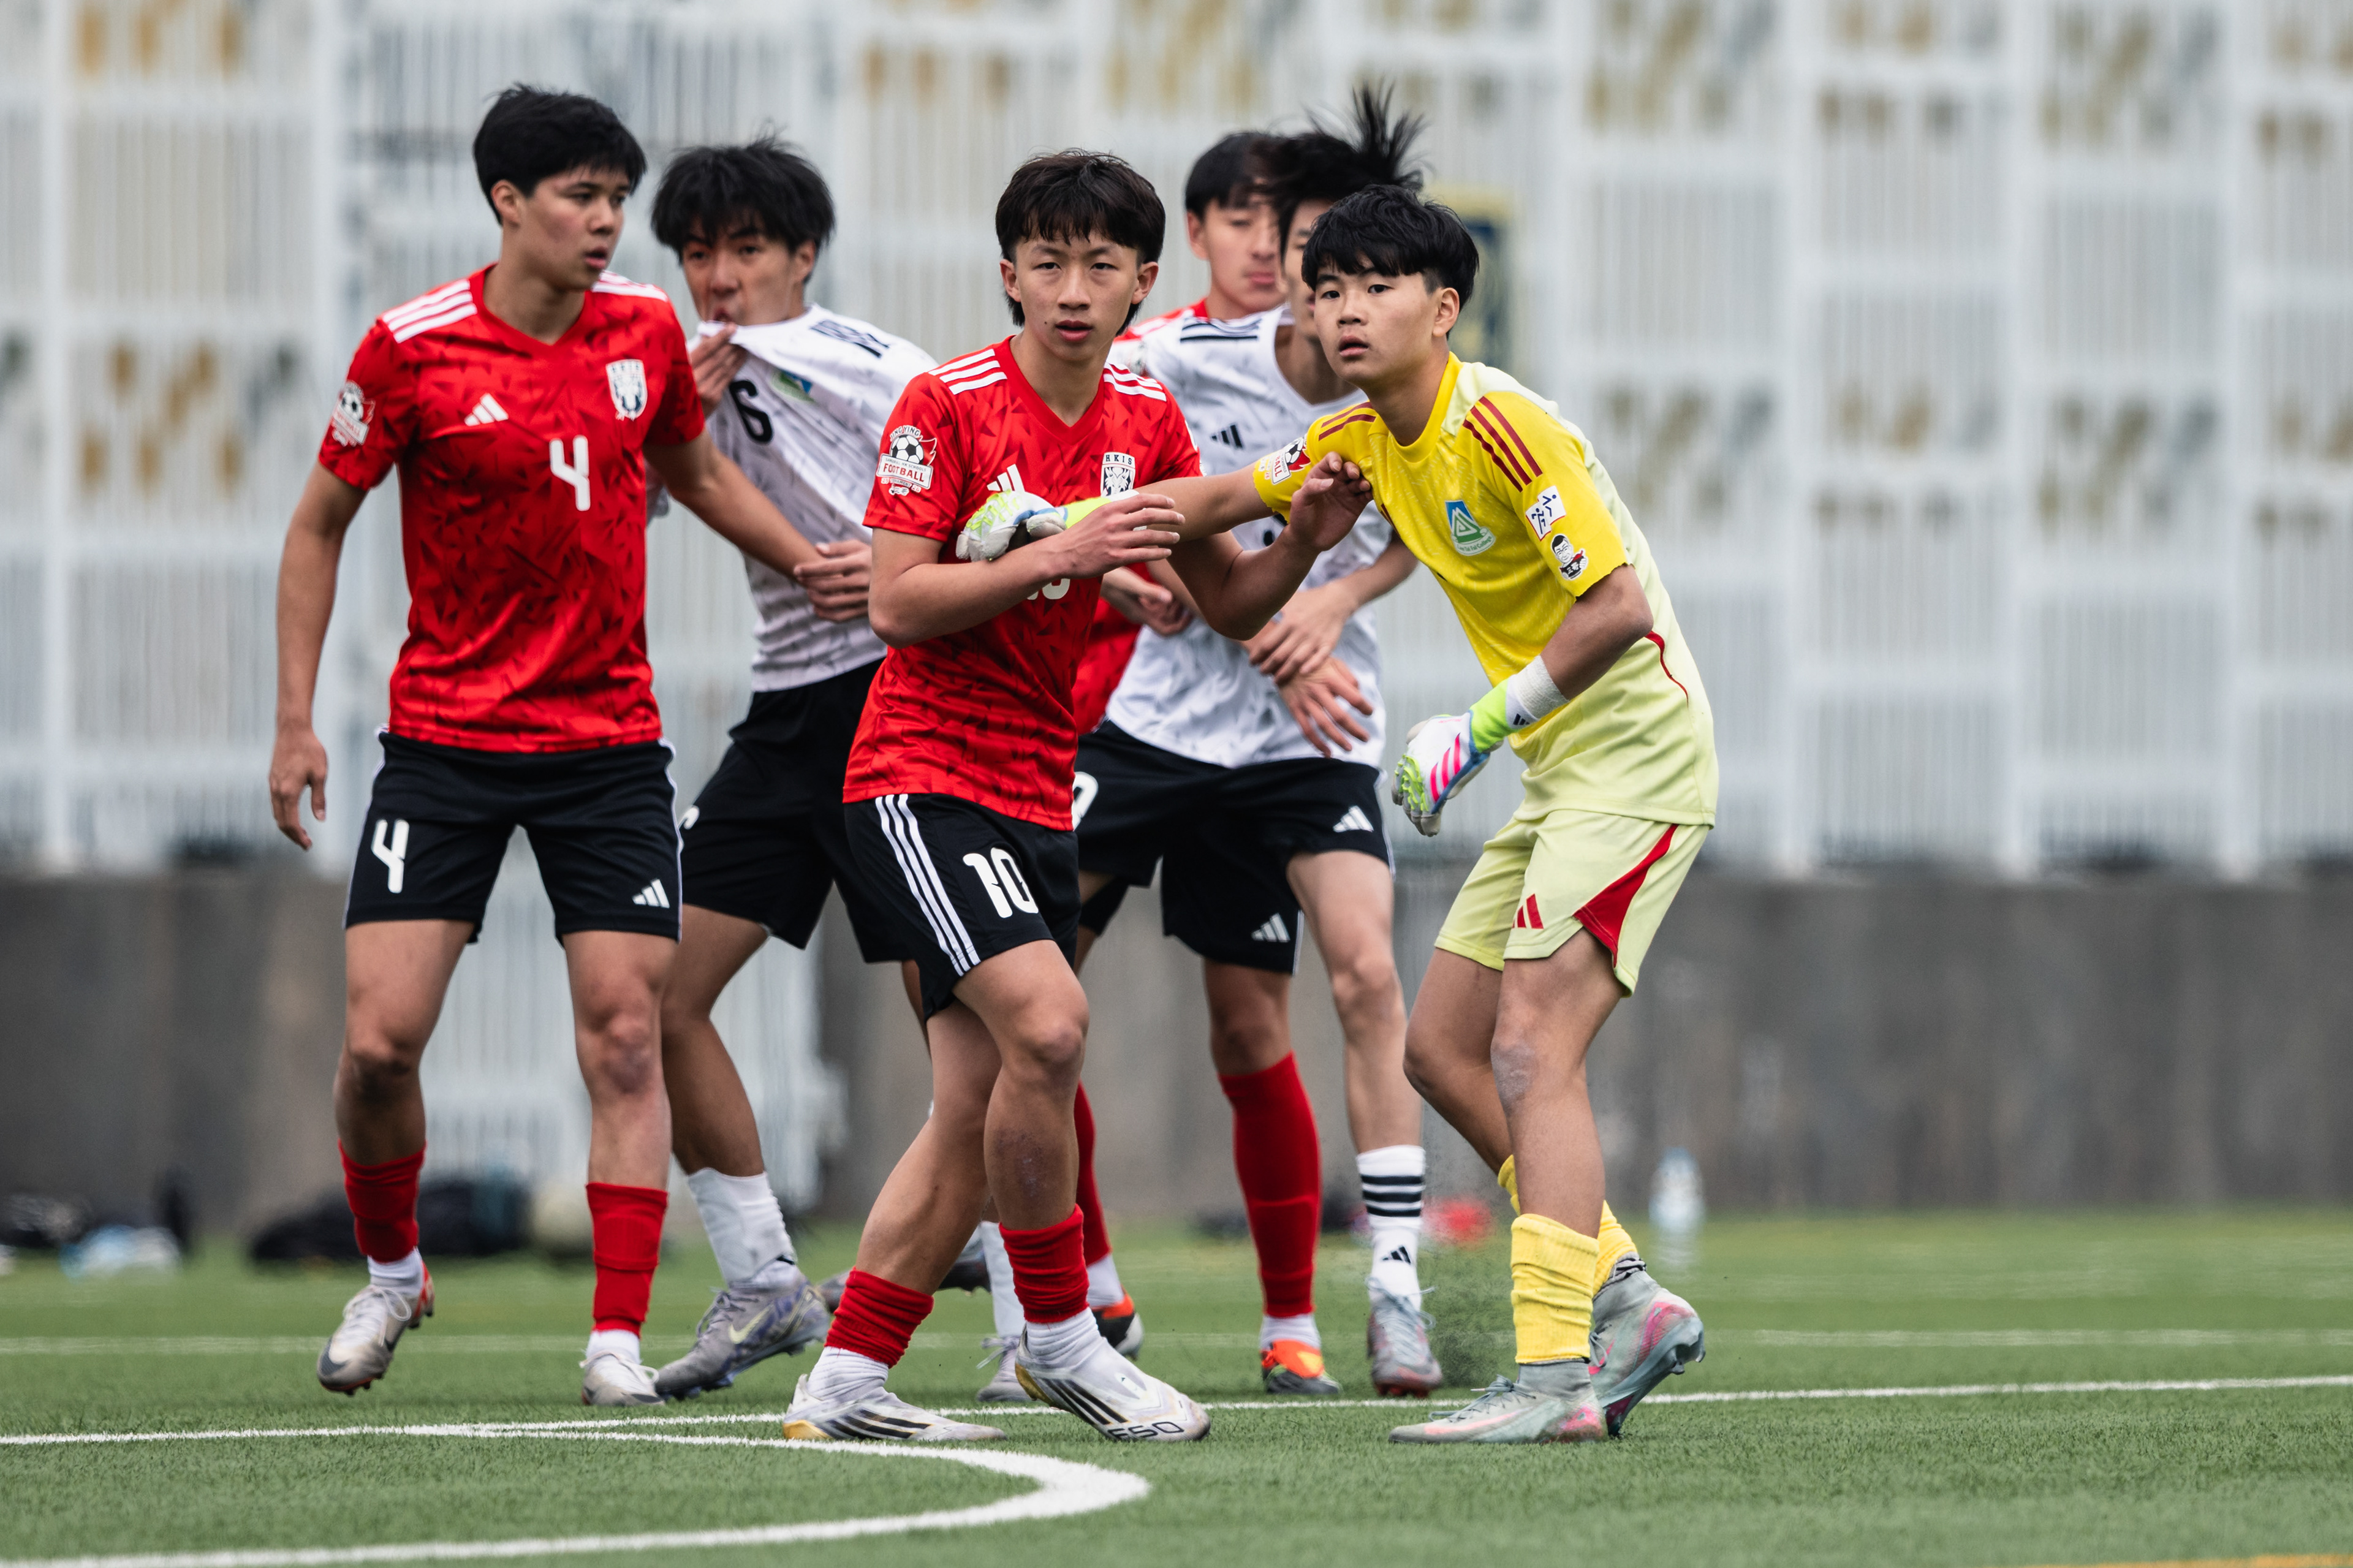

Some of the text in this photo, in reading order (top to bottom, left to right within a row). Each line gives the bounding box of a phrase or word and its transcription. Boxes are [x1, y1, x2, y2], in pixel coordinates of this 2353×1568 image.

[728, 379, 774, 446] 6
[904, 426, 920, 436] YING
[549, 434, 591, 512] 4
[883, 463, 924, 482] FOOTBALL
[1105, 454, 1132, 465] HKIS
[371, 819, 410, 894] 4
[963, 847, 1039, 918] 10
[1107, 1421, 1184, 1439] F50
